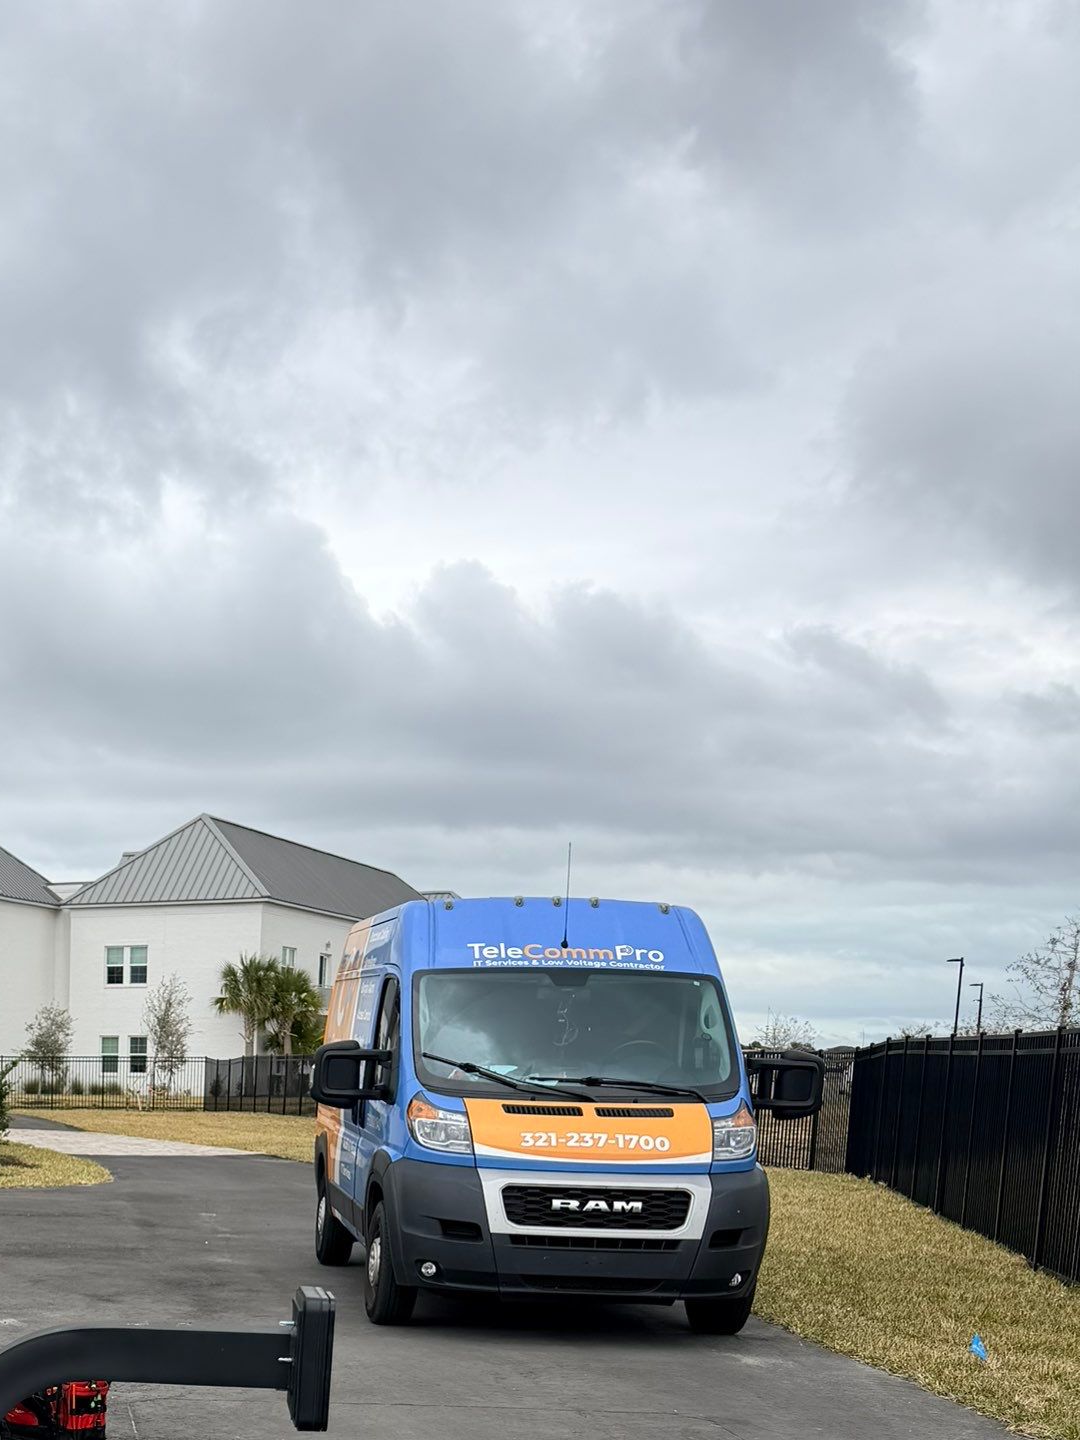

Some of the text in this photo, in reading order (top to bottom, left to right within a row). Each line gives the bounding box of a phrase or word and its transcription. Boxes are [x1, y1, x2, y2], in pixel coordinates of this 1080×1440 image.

[466, 943, 665, 963] TeleCommPro
[485, 959, 529, 967] Services
[566, 959, 607, 968] Voltage
[609, 961, 665, 970] Contractor
[520, 1132, 671, 1151] 321-237-1700
[551, 1199, 643, 1213] RAM
